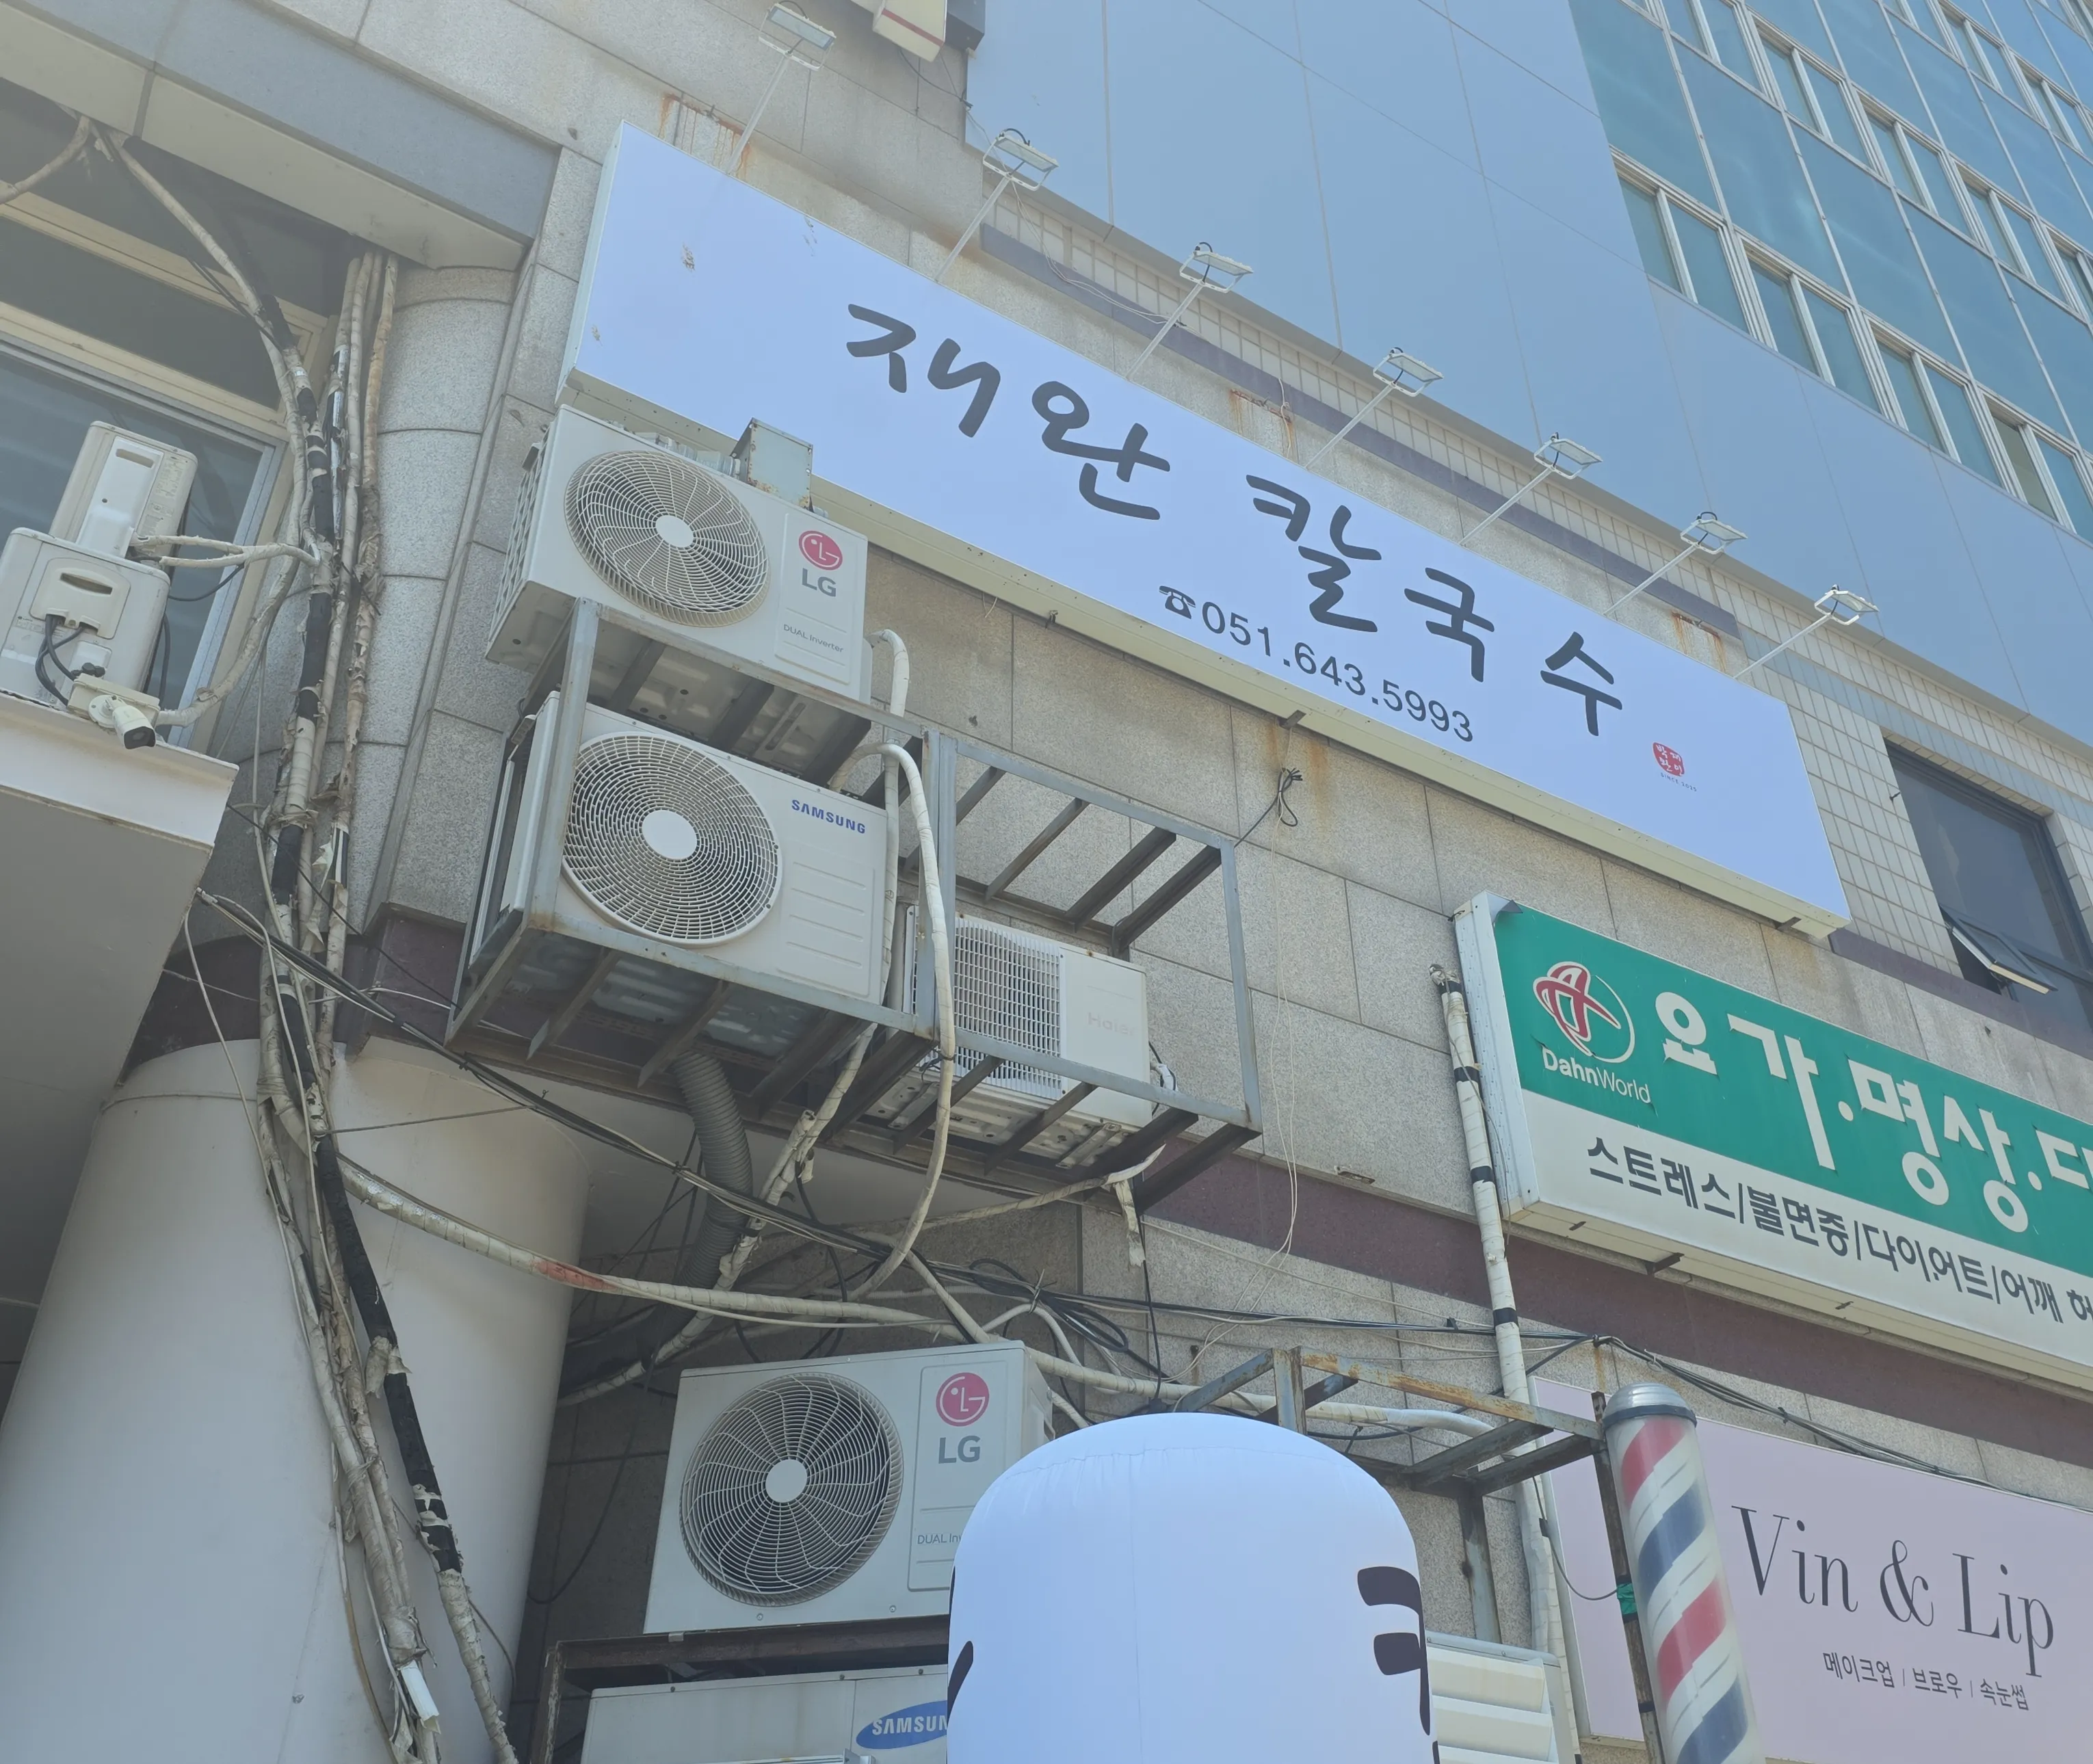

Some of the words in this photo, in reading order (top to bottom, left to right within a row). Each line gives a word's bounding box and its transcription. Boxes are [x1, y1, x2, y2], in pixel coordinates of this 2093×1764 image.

[846, 303, 1170, 521] 재완
[1246, 474, 1623, 737] 칼국수
[802, 568, 837, 597] LG
[783, 624, 808, 640] DUAL
[809, 634, 844, 653] Inverter
[1202, 601, 1475, 743] 051.643.5993
[791, 800, 866, 834] SAMSUNG
[1542, 1046, 1652, 1104] DahnWorld
[938, 1435, 981, 1464] LG
[917, 1533, 947, 1544] DUAL
[1731, 1505, 1858, 1613] Vin
[1880, 1540, 1934, 1627] &
[1952, 1553, 2054, 1678] Lip
[1823, 1652, 1895, 1689] 메이크업
[1912, 1668, 1962, 1699] 브로우
[1980, 1678, 2029, 1711] 속눈썹
[872, 1715, 947, 1735] SAMSUN
